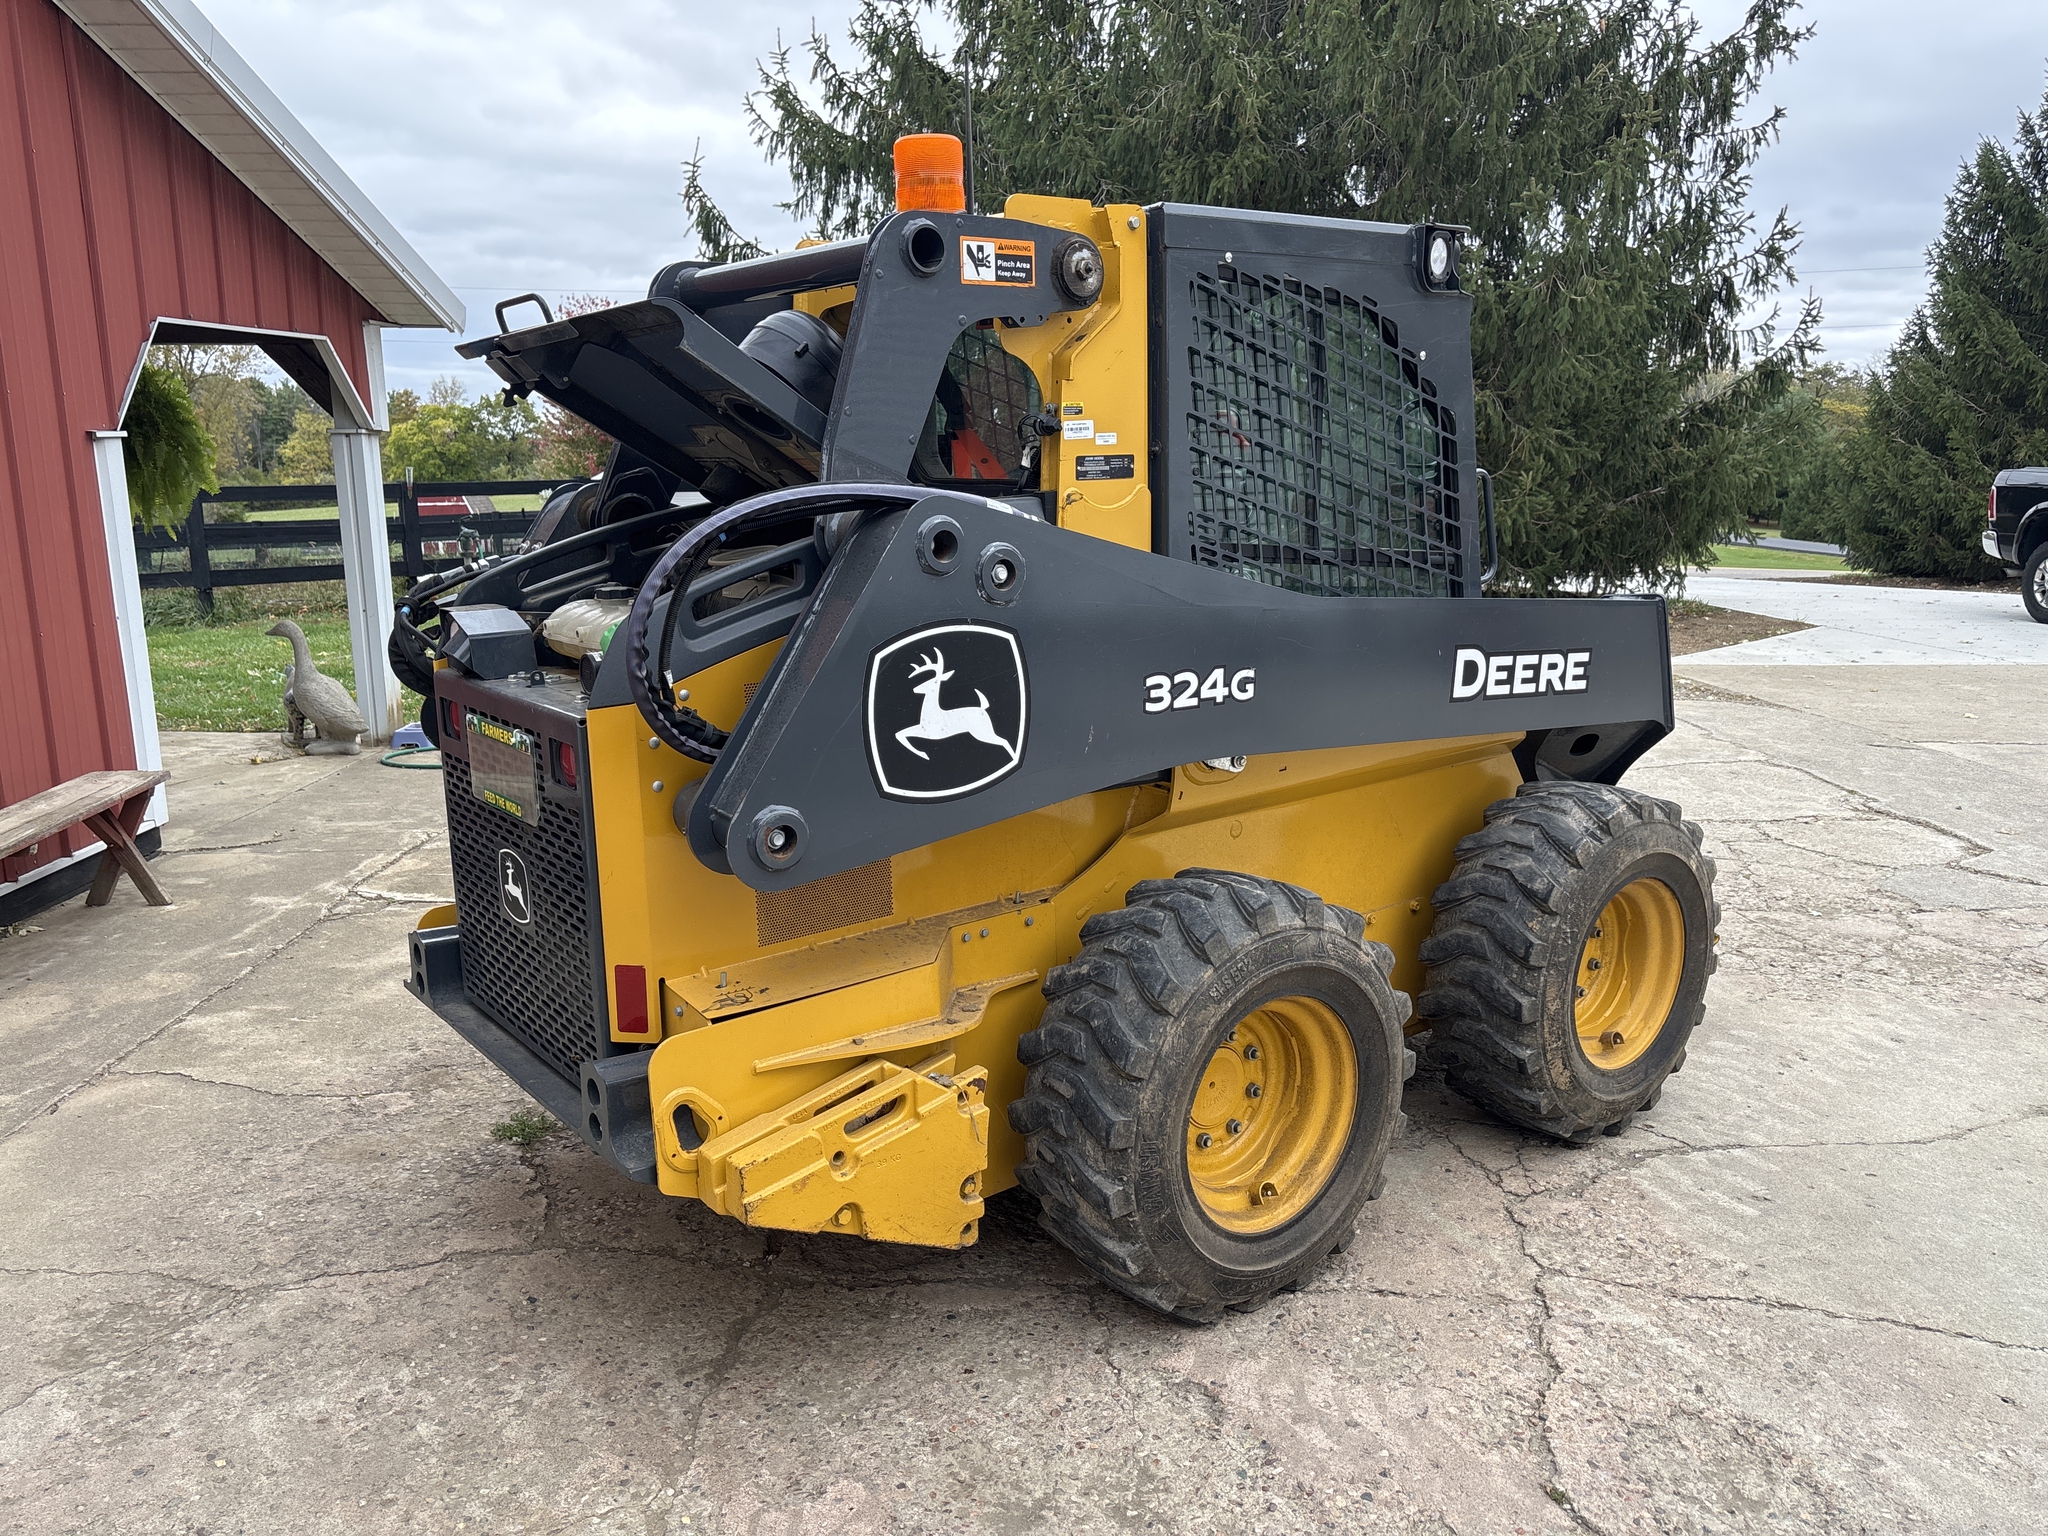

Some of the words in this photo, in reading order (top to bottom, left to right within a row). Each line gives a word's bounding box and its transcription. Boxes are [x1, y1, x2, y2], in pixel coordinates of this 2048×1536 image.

[1004, 243, 1032, 253] WARNING
[997, 259, 1015, 268] Pinch
[1015, 261, 1031, 269] Area
[997, 270, 1011, 278] Keep
[1011, 271, 1026, 279] Away
[1452, 647, 1591, 700] DEERE
[1144, 666, 1256, 713] 324G
[481, 721, 515, 746] FARMERS
[484, 789, 497, 805] FEED
[495, 795, 507, 810] THE
[505, 801, 522, 818] WORLD
[822, 1121, 839, 1133] USA
